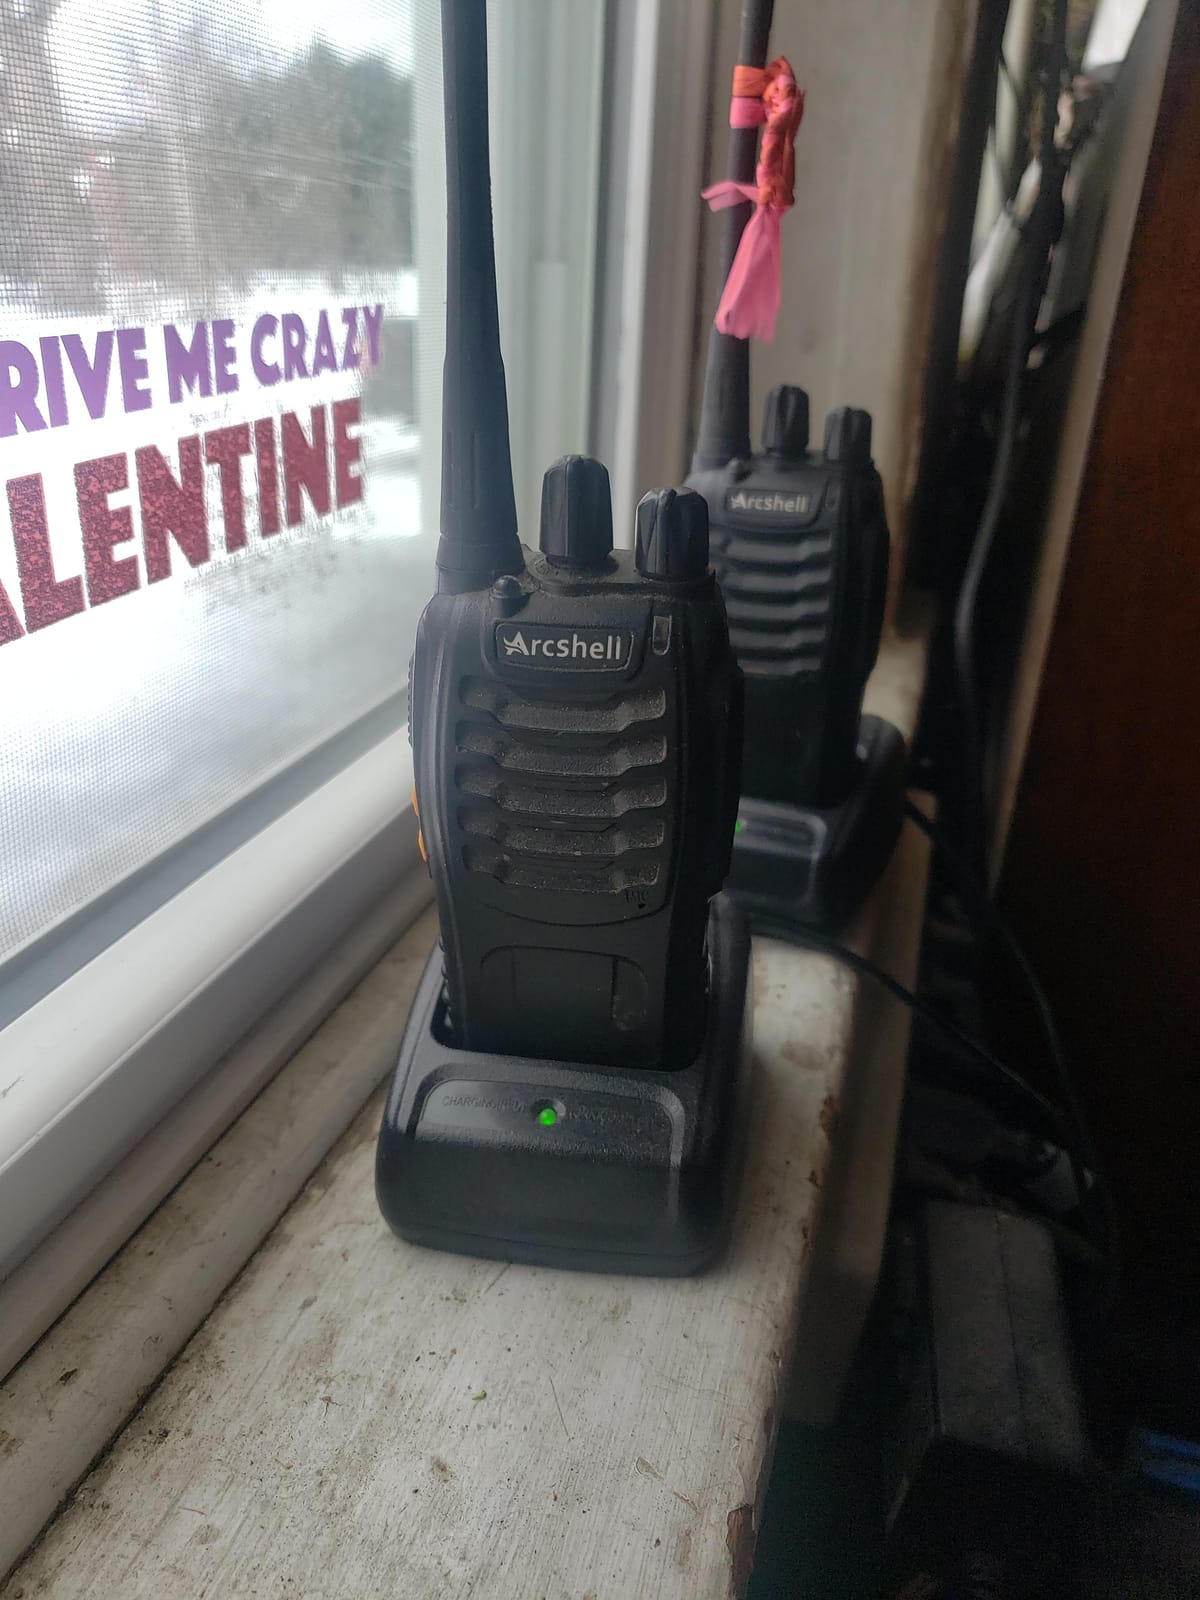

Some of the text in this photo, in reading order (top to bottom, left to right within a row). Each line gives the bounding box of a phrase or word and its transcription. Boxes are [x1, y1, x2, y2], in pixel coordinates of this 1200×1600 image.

[163, 318, 239, 404] ME
[250, 304, 384, 387] CRAZY
[0, 397, 364, 647] LENTINE
[731, 492, 807, 513] Arcshell
[503, 631, 622, 660] Arcshell
